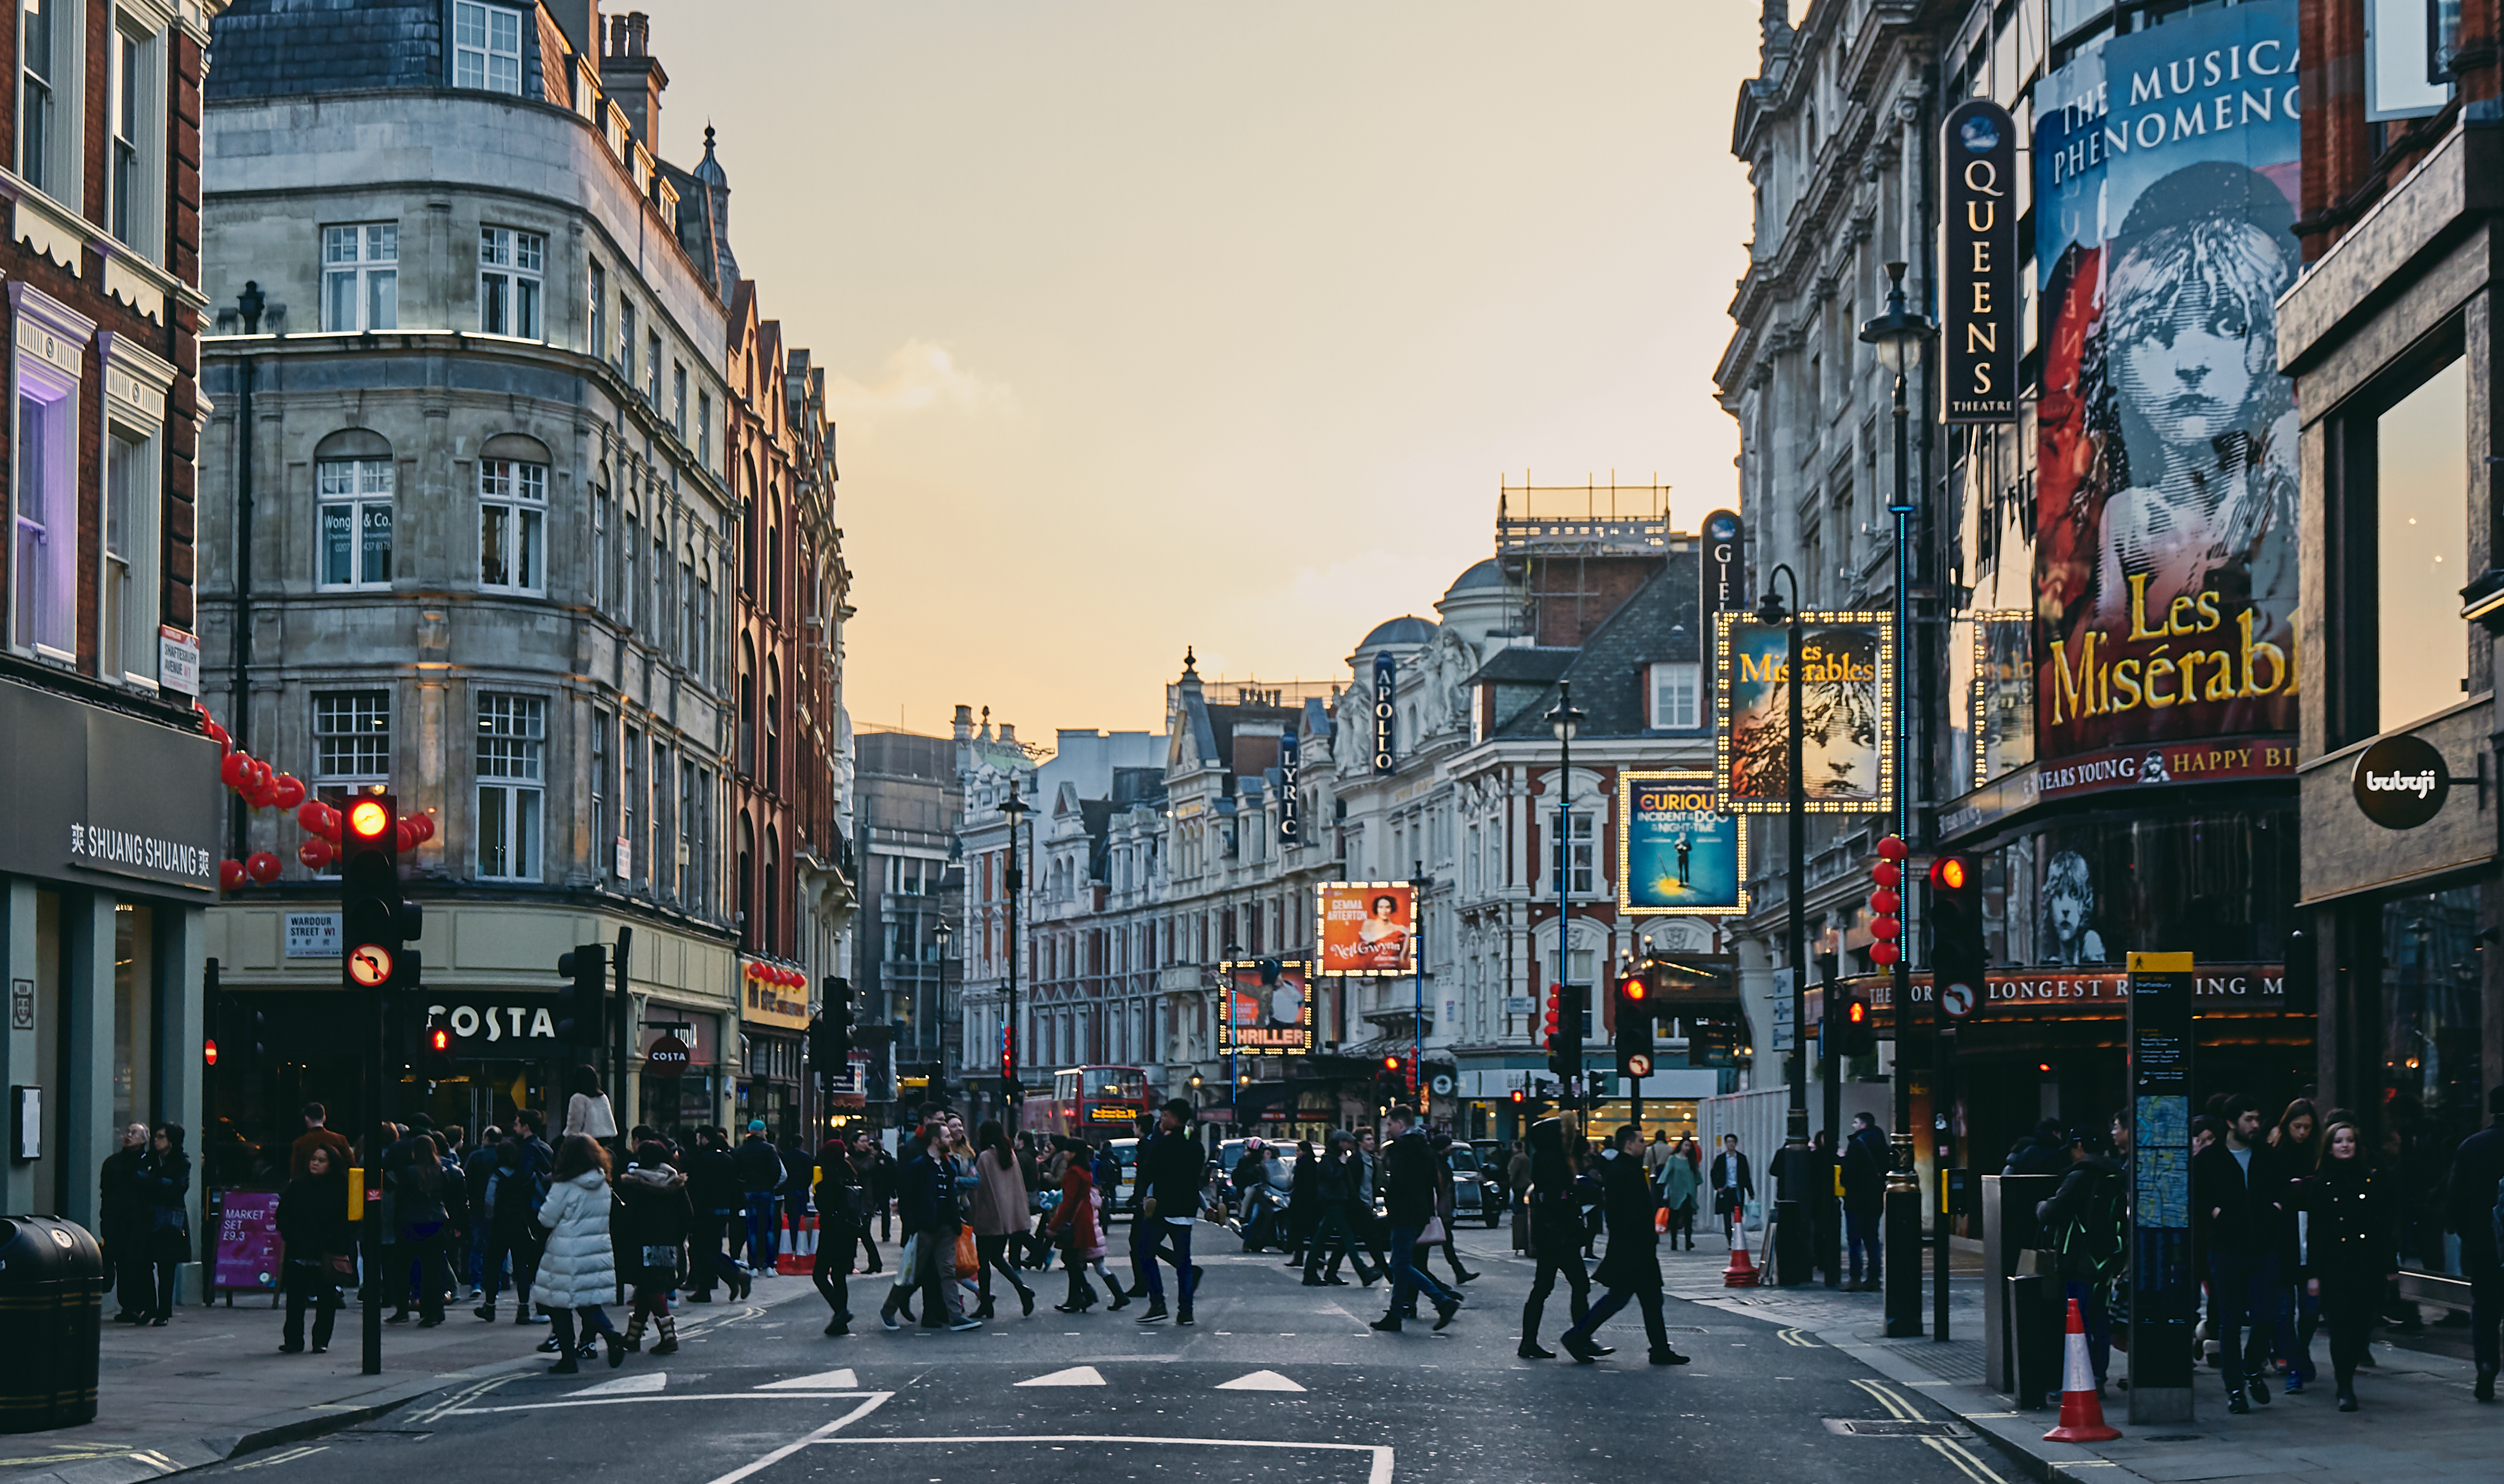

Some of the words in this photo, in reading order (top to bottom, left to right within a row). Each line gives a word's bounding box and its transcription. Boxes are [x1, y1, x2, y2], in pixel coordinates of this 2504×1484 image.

[2062, 81, 2108, 136] THE
[1964, 160, 2004, 394] QUEENS
[1952, 400, 2013, 412] THEATRE
[324, 514, 351, 532] Wong
[364, 513, 372, 528] &
[374, 513, 392, 528] Co.
[2127, 572, 2221, 642] Les
[1801, 646, 1822, 661] es
[1739, 652, 1875, 683] Misrables
[1376, 669, 1393, 769] APOLLO
[2173, 748, 2252, 773] HAPPY
[2038, 766, 2076, 791] YEARS
[2077, 757, 2135, 784] YOUNG
[2366, 770, 2435, 800] babaji
[1281, 750, 1298, 835] LYRIC
[71, 821, 85, 855] 爽
[88, 825, 143, 865] SHUANG
[145, 837, 196, 875] SHUANG
[198, 848, 210, 877] 爽
[1327, 910, 1368, 921] ARTERTON
[1332, 899, 1363, 910] GEMMA
[290, 927, 318, 936] STREET
[324, 927, 335, 936] W1
[291, 917, 332, 926] WARDOUR
[1330, 942, 1357, 960] Nell
[1357, 941, 1401, 955] Gwynn
[1869, 987, 1892, 1004] THE
[1989, 980, 2103, 999] LONGEST
[652, 1052, 686, 1062] COSTA
[224, 1220, 243, 1231] SET
[225, 1209, 265, 1220] MARKET
